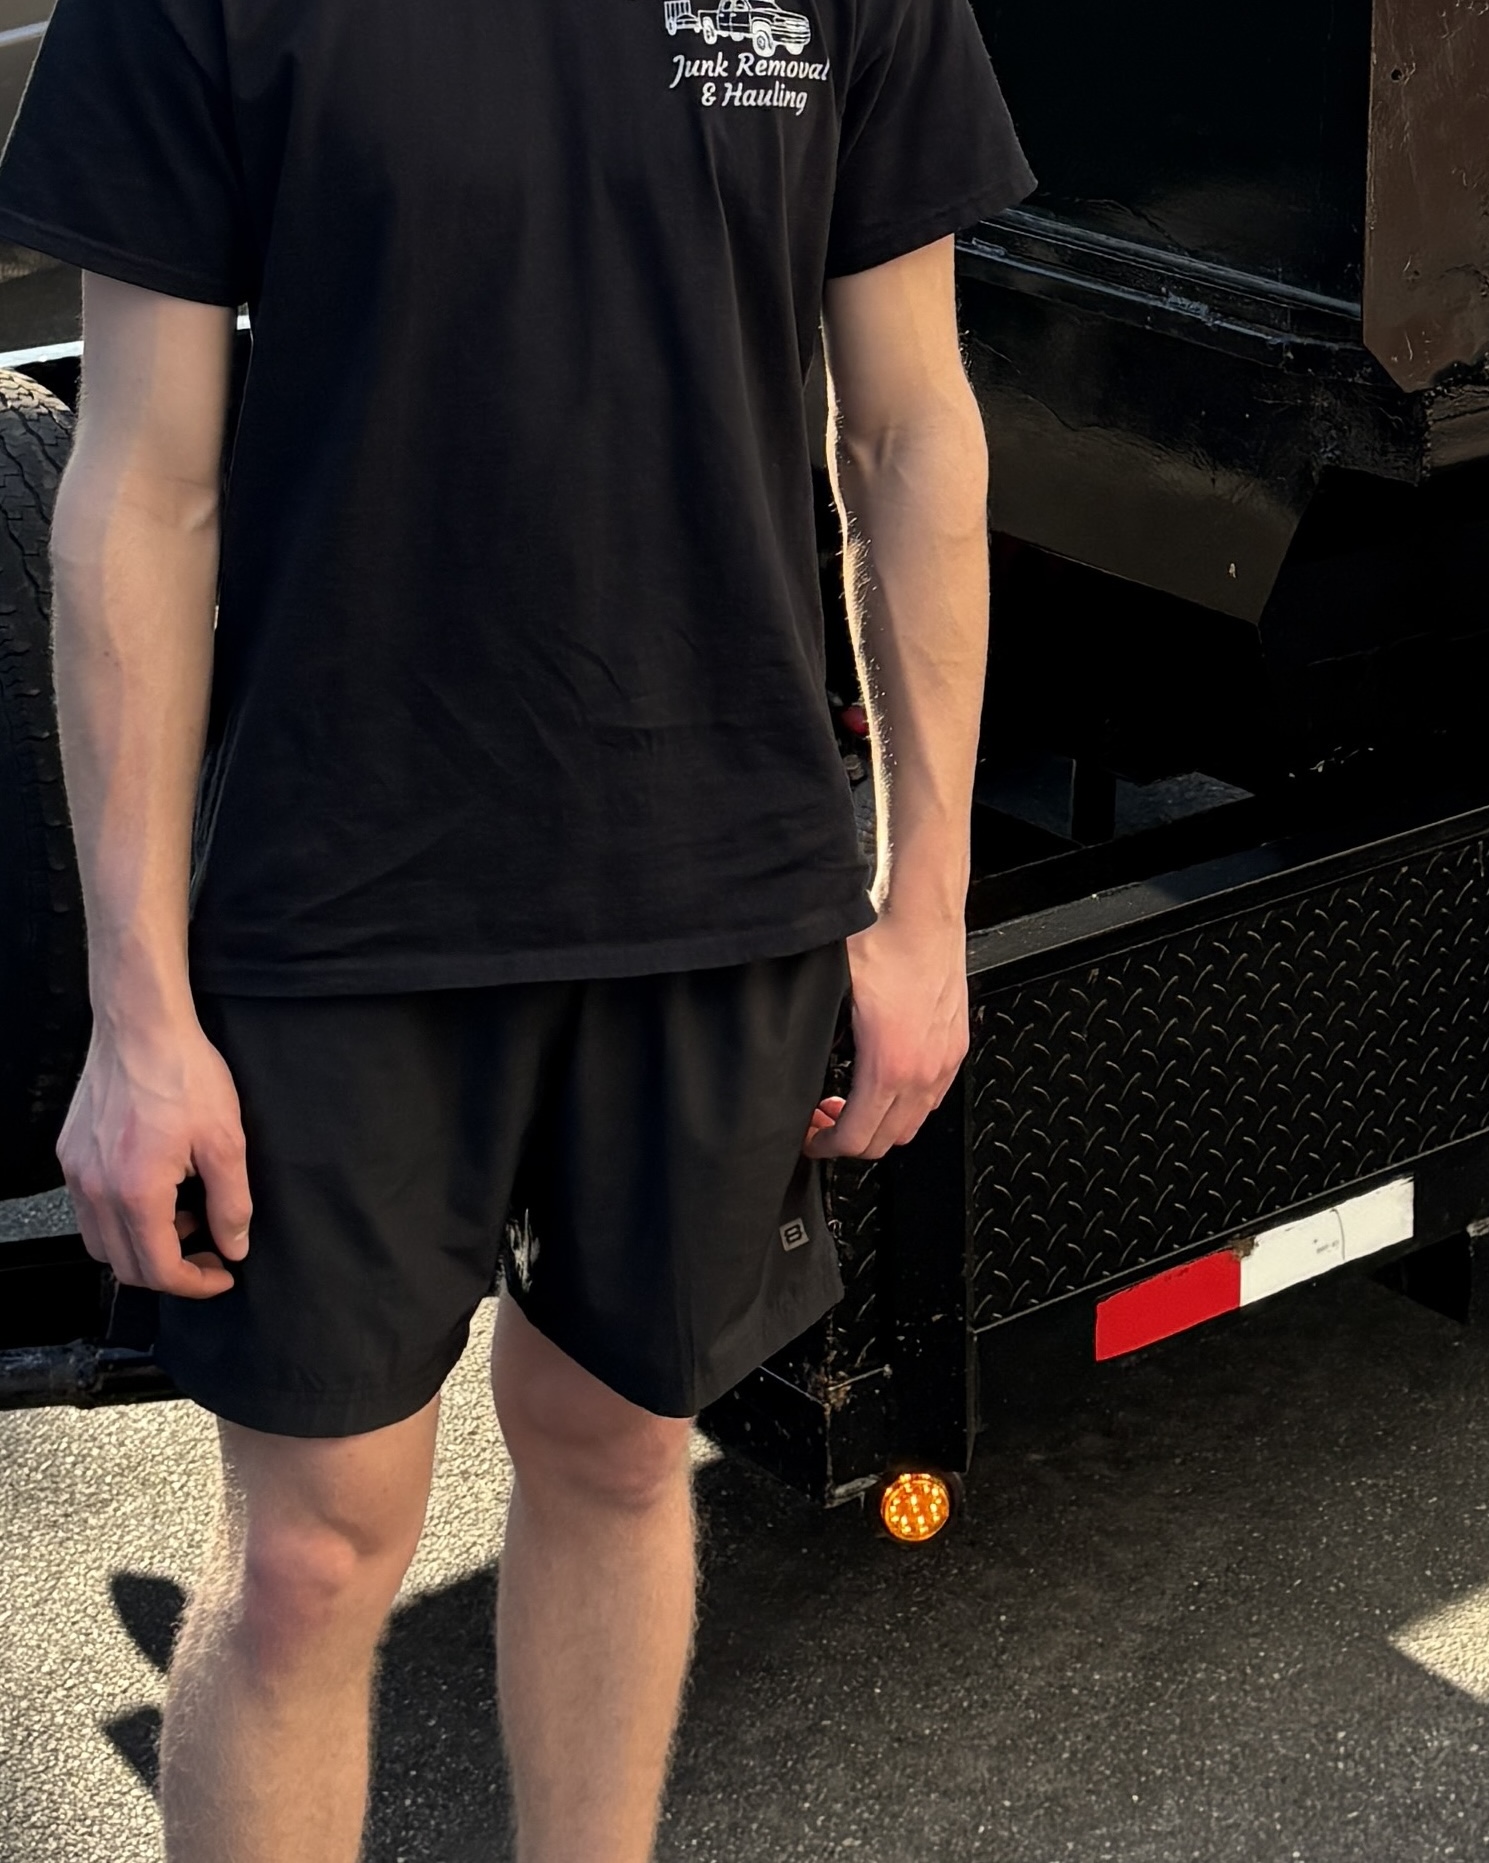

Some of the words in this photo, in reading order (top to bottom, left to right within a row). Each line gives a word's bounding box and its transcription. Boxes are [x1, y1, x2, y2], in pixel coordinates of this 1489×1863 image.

[669, 51, 729, 89] Junk
[735, 52, 830, 81] Removal
[701, 81, 717, 107] &
[721, 80, 808, 116] Hauling
